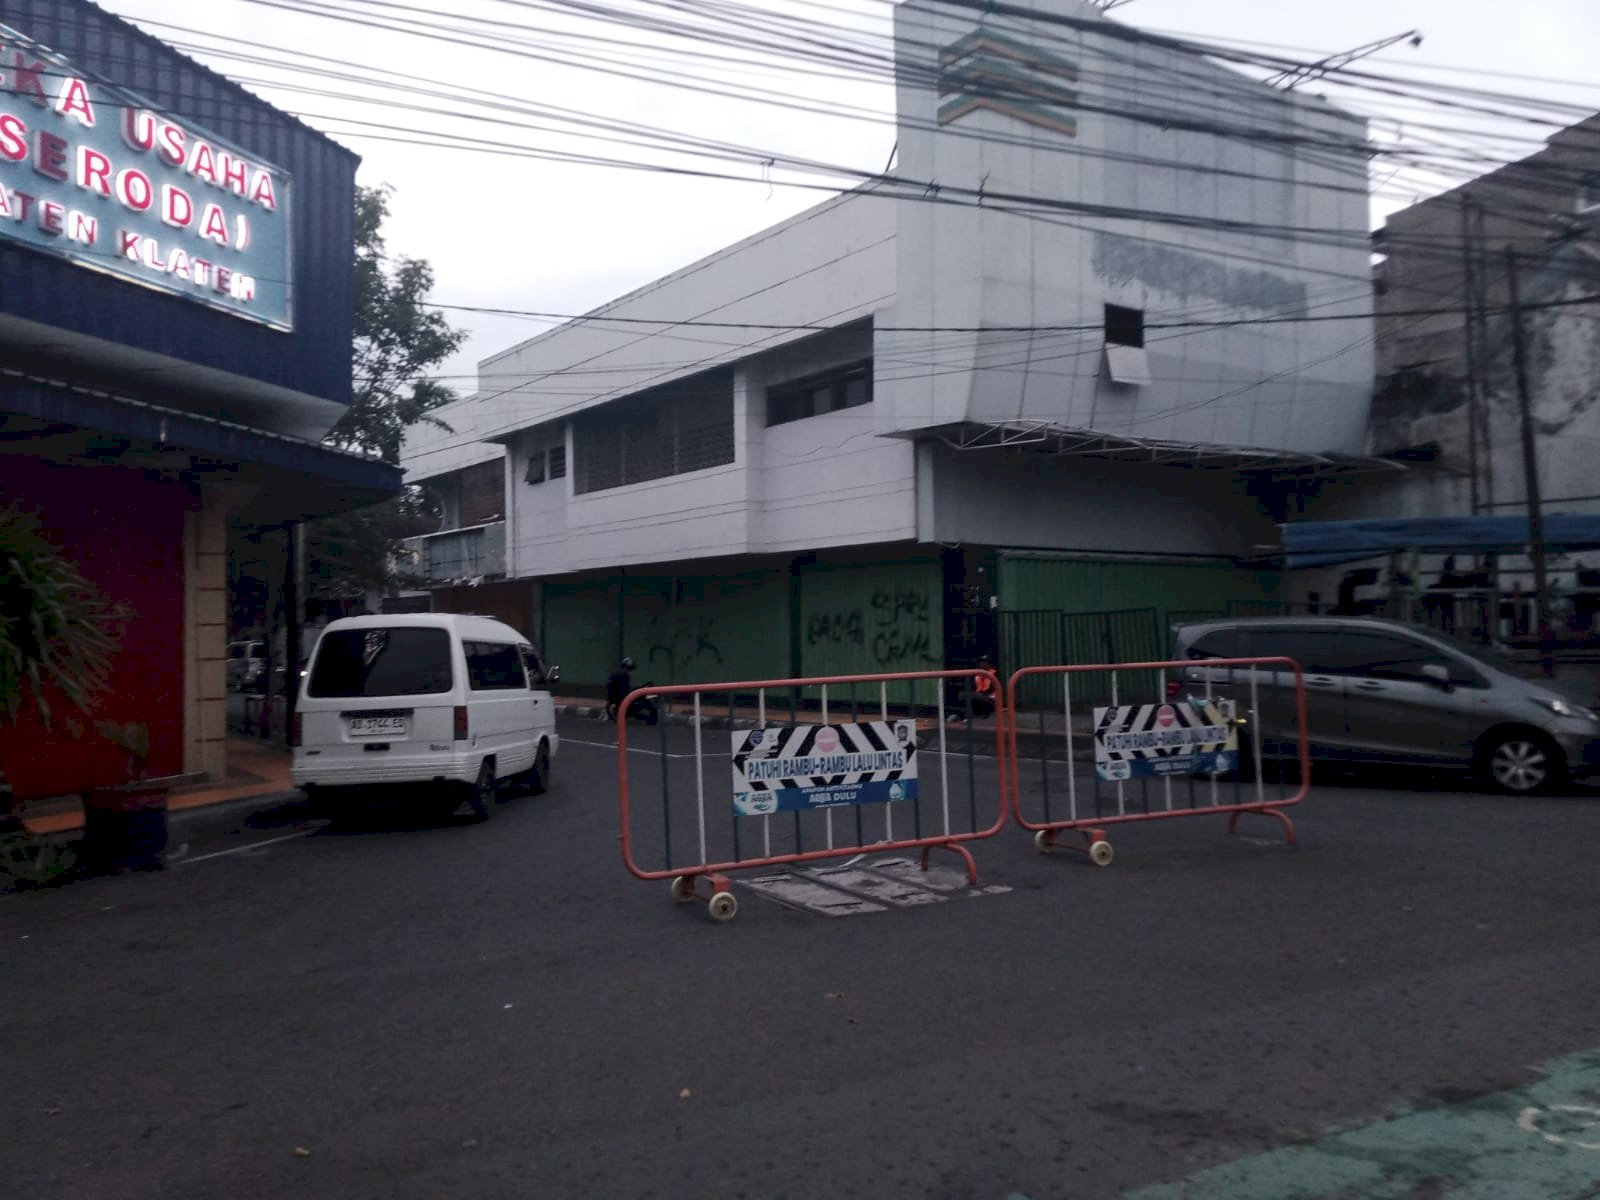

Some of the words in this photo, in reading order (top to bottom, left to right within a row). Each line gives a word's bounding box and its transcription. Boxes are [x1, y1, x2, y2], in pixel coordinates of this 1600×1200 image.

[0, 44, 96, 128] KA
[121, 106, 276, 211] USAHA
[118, 230, 256, 302] KLATEN
[748, 760, 782, 780] PATUHI
[783, 754, 851, 778] RAMBU-RAMBU
[852, 755, 874, 772] LALU
[874, 752, 904, 770] LINTAS
[833, 791, 857, 801] DULU
